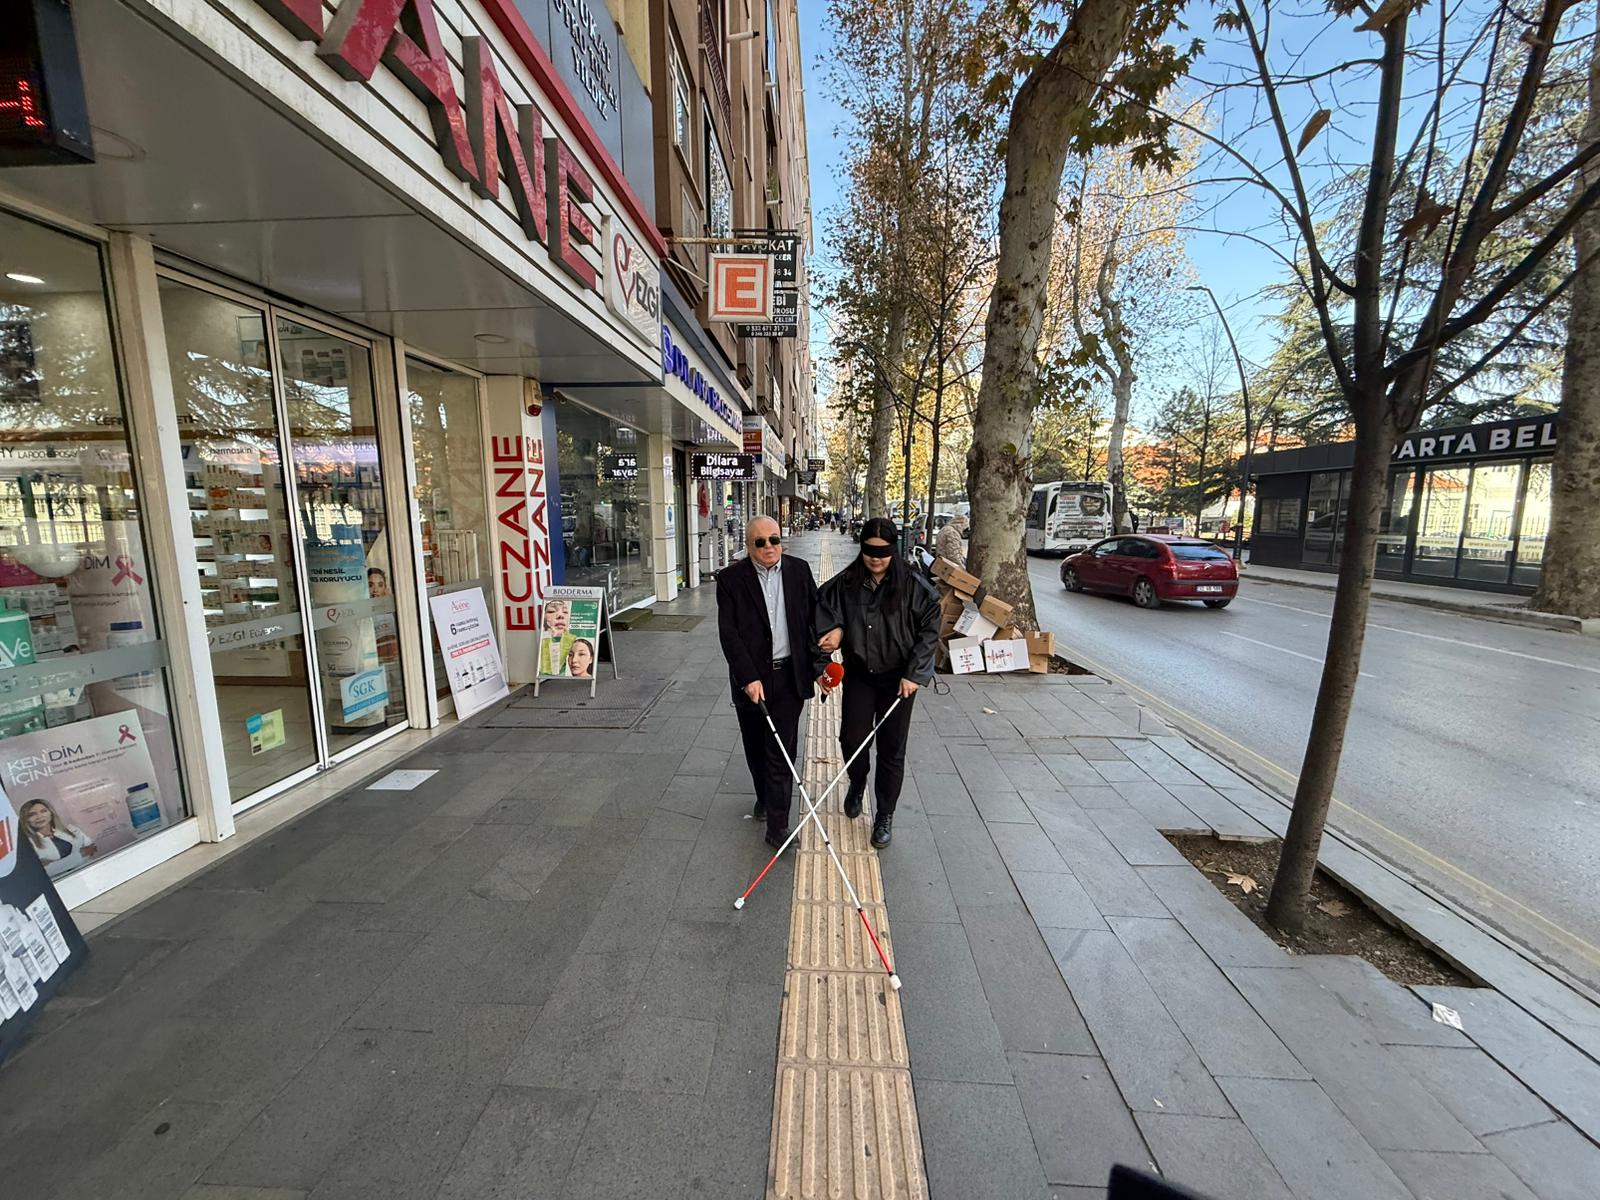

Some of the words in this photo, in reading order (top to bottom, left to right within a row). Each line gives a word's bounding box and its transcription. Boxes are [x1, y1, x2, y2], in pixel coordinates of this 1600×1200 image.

[636, 272, 660, 323] EZGİ
[725, 268, 757, 308] E
[1489, 422, 1558, 451] BEL
[700, 467, 745, 478] Bilgisayar
[706, 455, 738, 466] Dilara
[492, 435, 536, 631] ECZANE
[449, 623, 458, 636] 6
[353, 679, 376, 698] SGK
